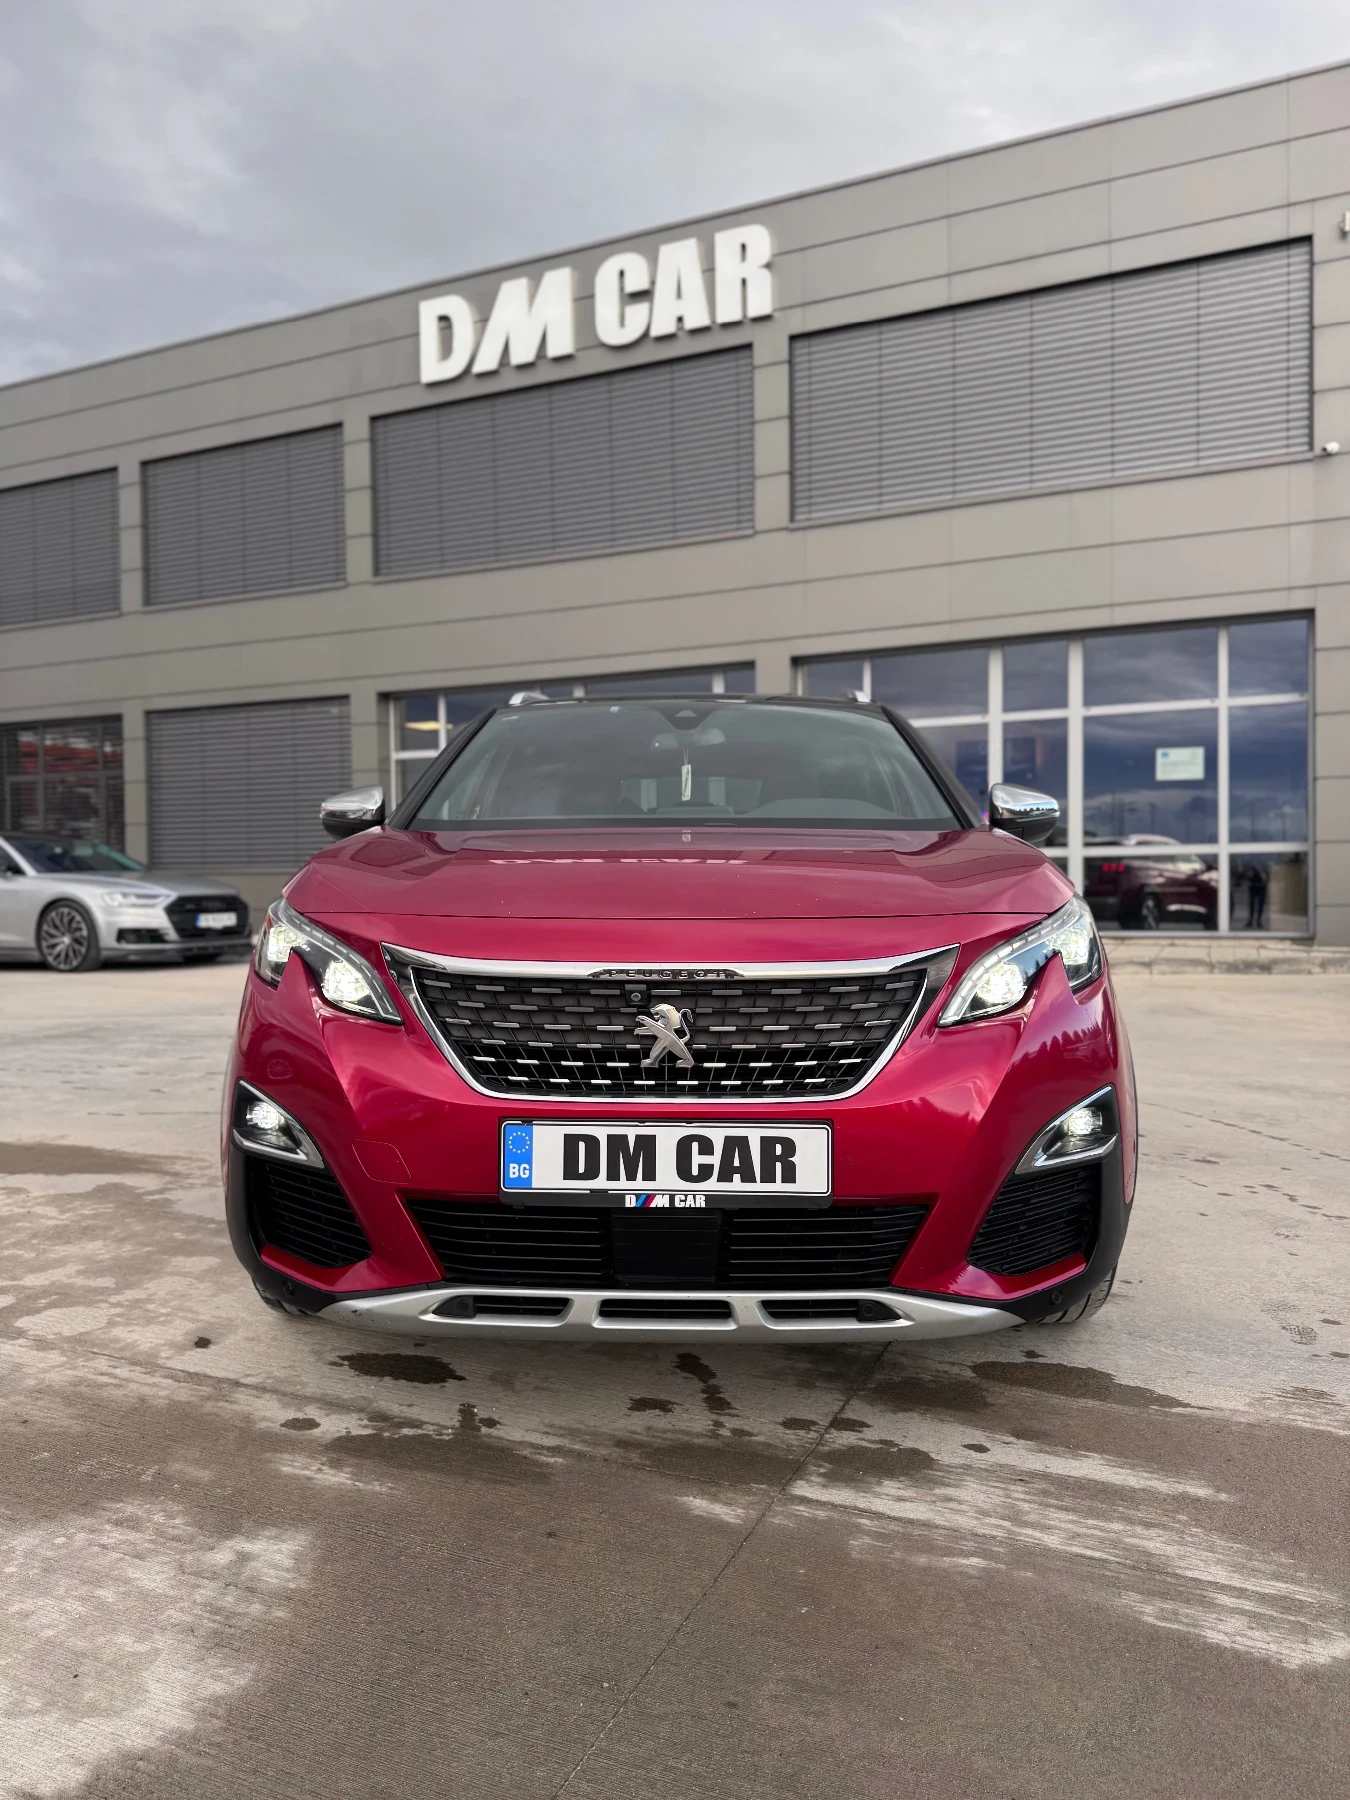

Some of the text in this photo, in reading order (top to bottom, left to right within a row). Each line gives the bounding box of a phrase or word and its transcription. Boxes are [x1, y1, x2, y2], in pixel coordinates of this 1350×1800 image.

[419, 224, 773, 384] DM CAR
[608, 969, 723, 979] PEUGEOT
[563, 1133, 797, 1184] DM CAR
[509, 1163, 530, 1179] BG
[674, 1194, 706, 1208] CAR
